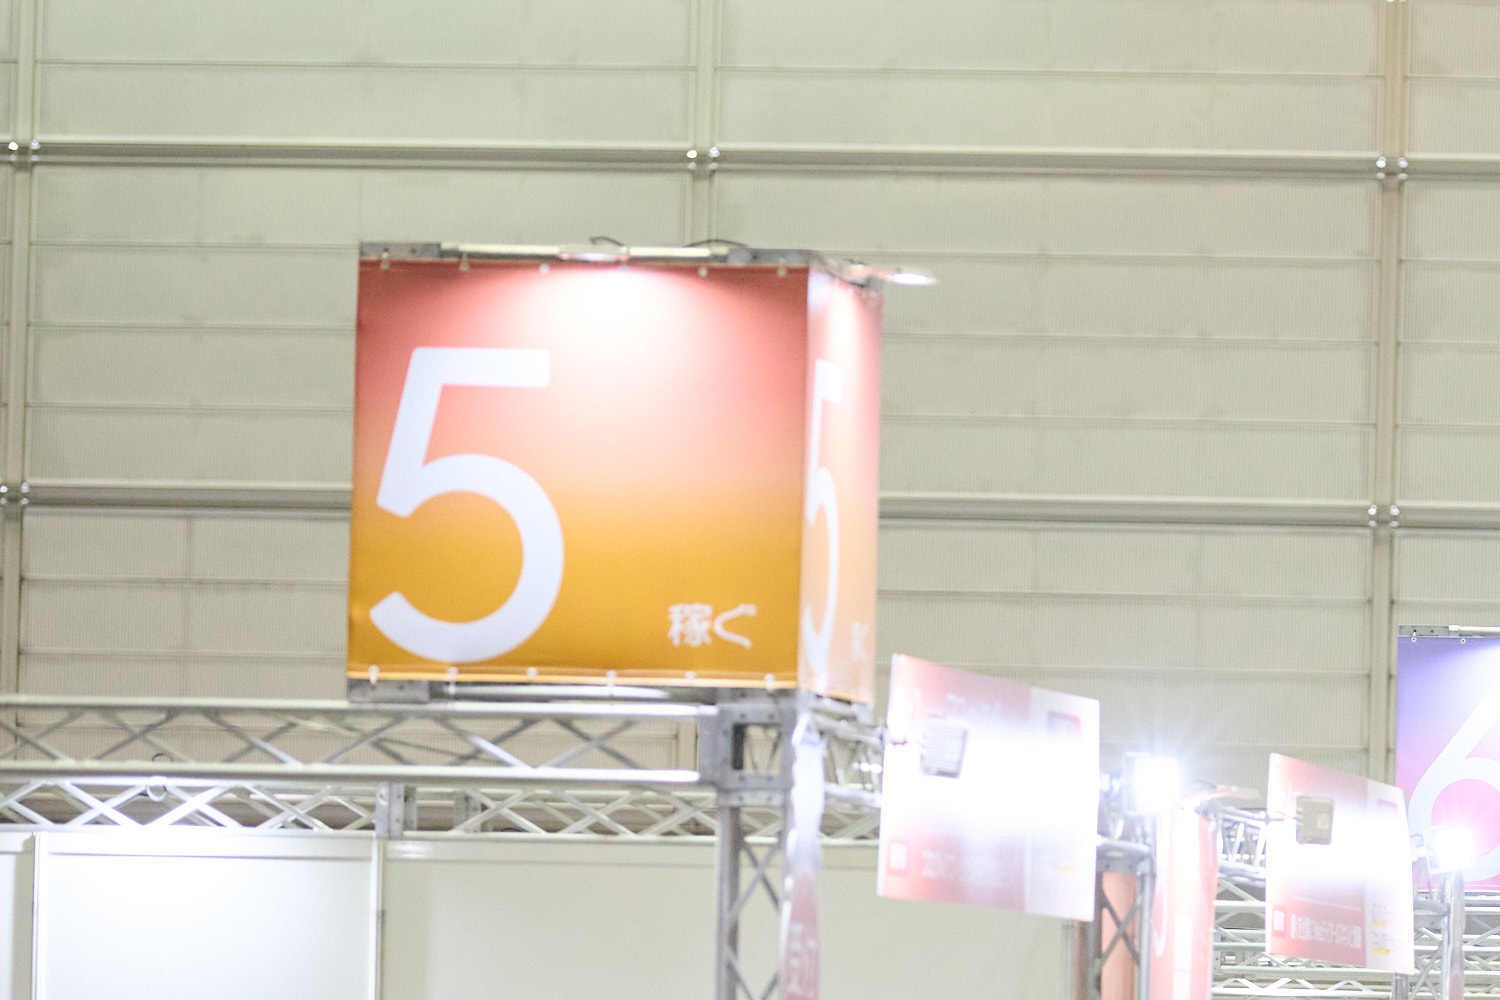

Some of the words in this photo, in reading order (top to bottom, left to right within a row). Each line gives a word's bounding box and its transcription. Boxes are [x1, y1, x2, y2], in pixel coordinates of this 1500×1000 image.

[369, 346, 565, 664] 5
[667, 603, 757, 648] 稼ぐ
[805, 360, 842, 691] 5
